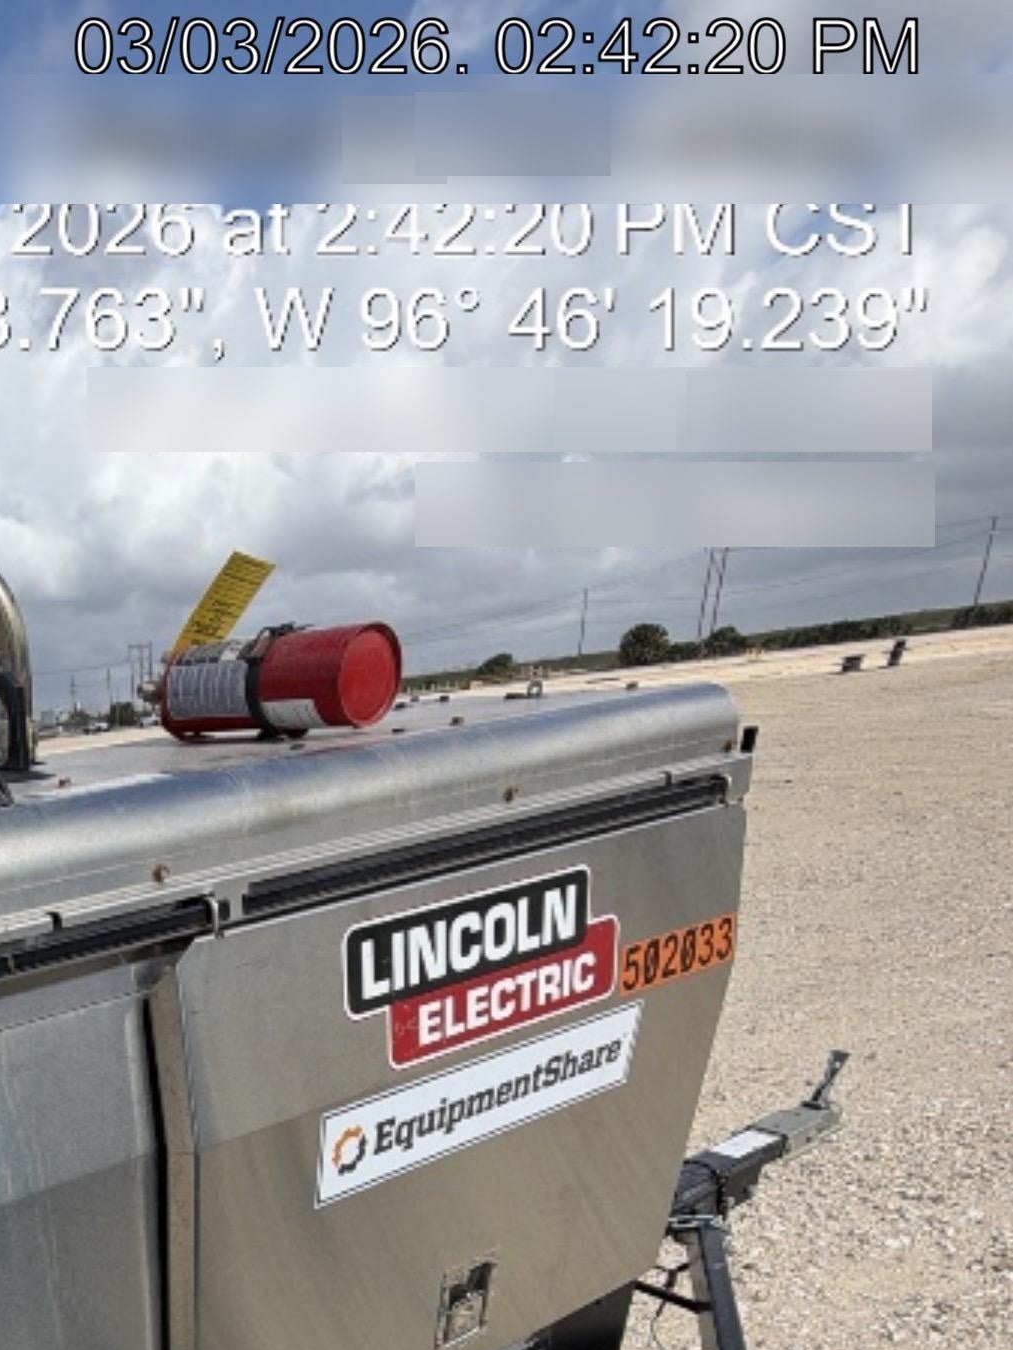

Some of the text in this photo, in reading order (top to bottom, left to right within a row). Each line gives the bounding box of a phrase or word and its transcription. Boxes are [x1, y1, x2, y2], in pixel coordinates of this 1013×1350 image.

[360, 884, 577, 1000] LINCOLN
[622, 916, 734, 991] 502033
[418, 952, 596, 1047] ELECTRIC
[372, 1037, 622, 1155] EquipmentShare
